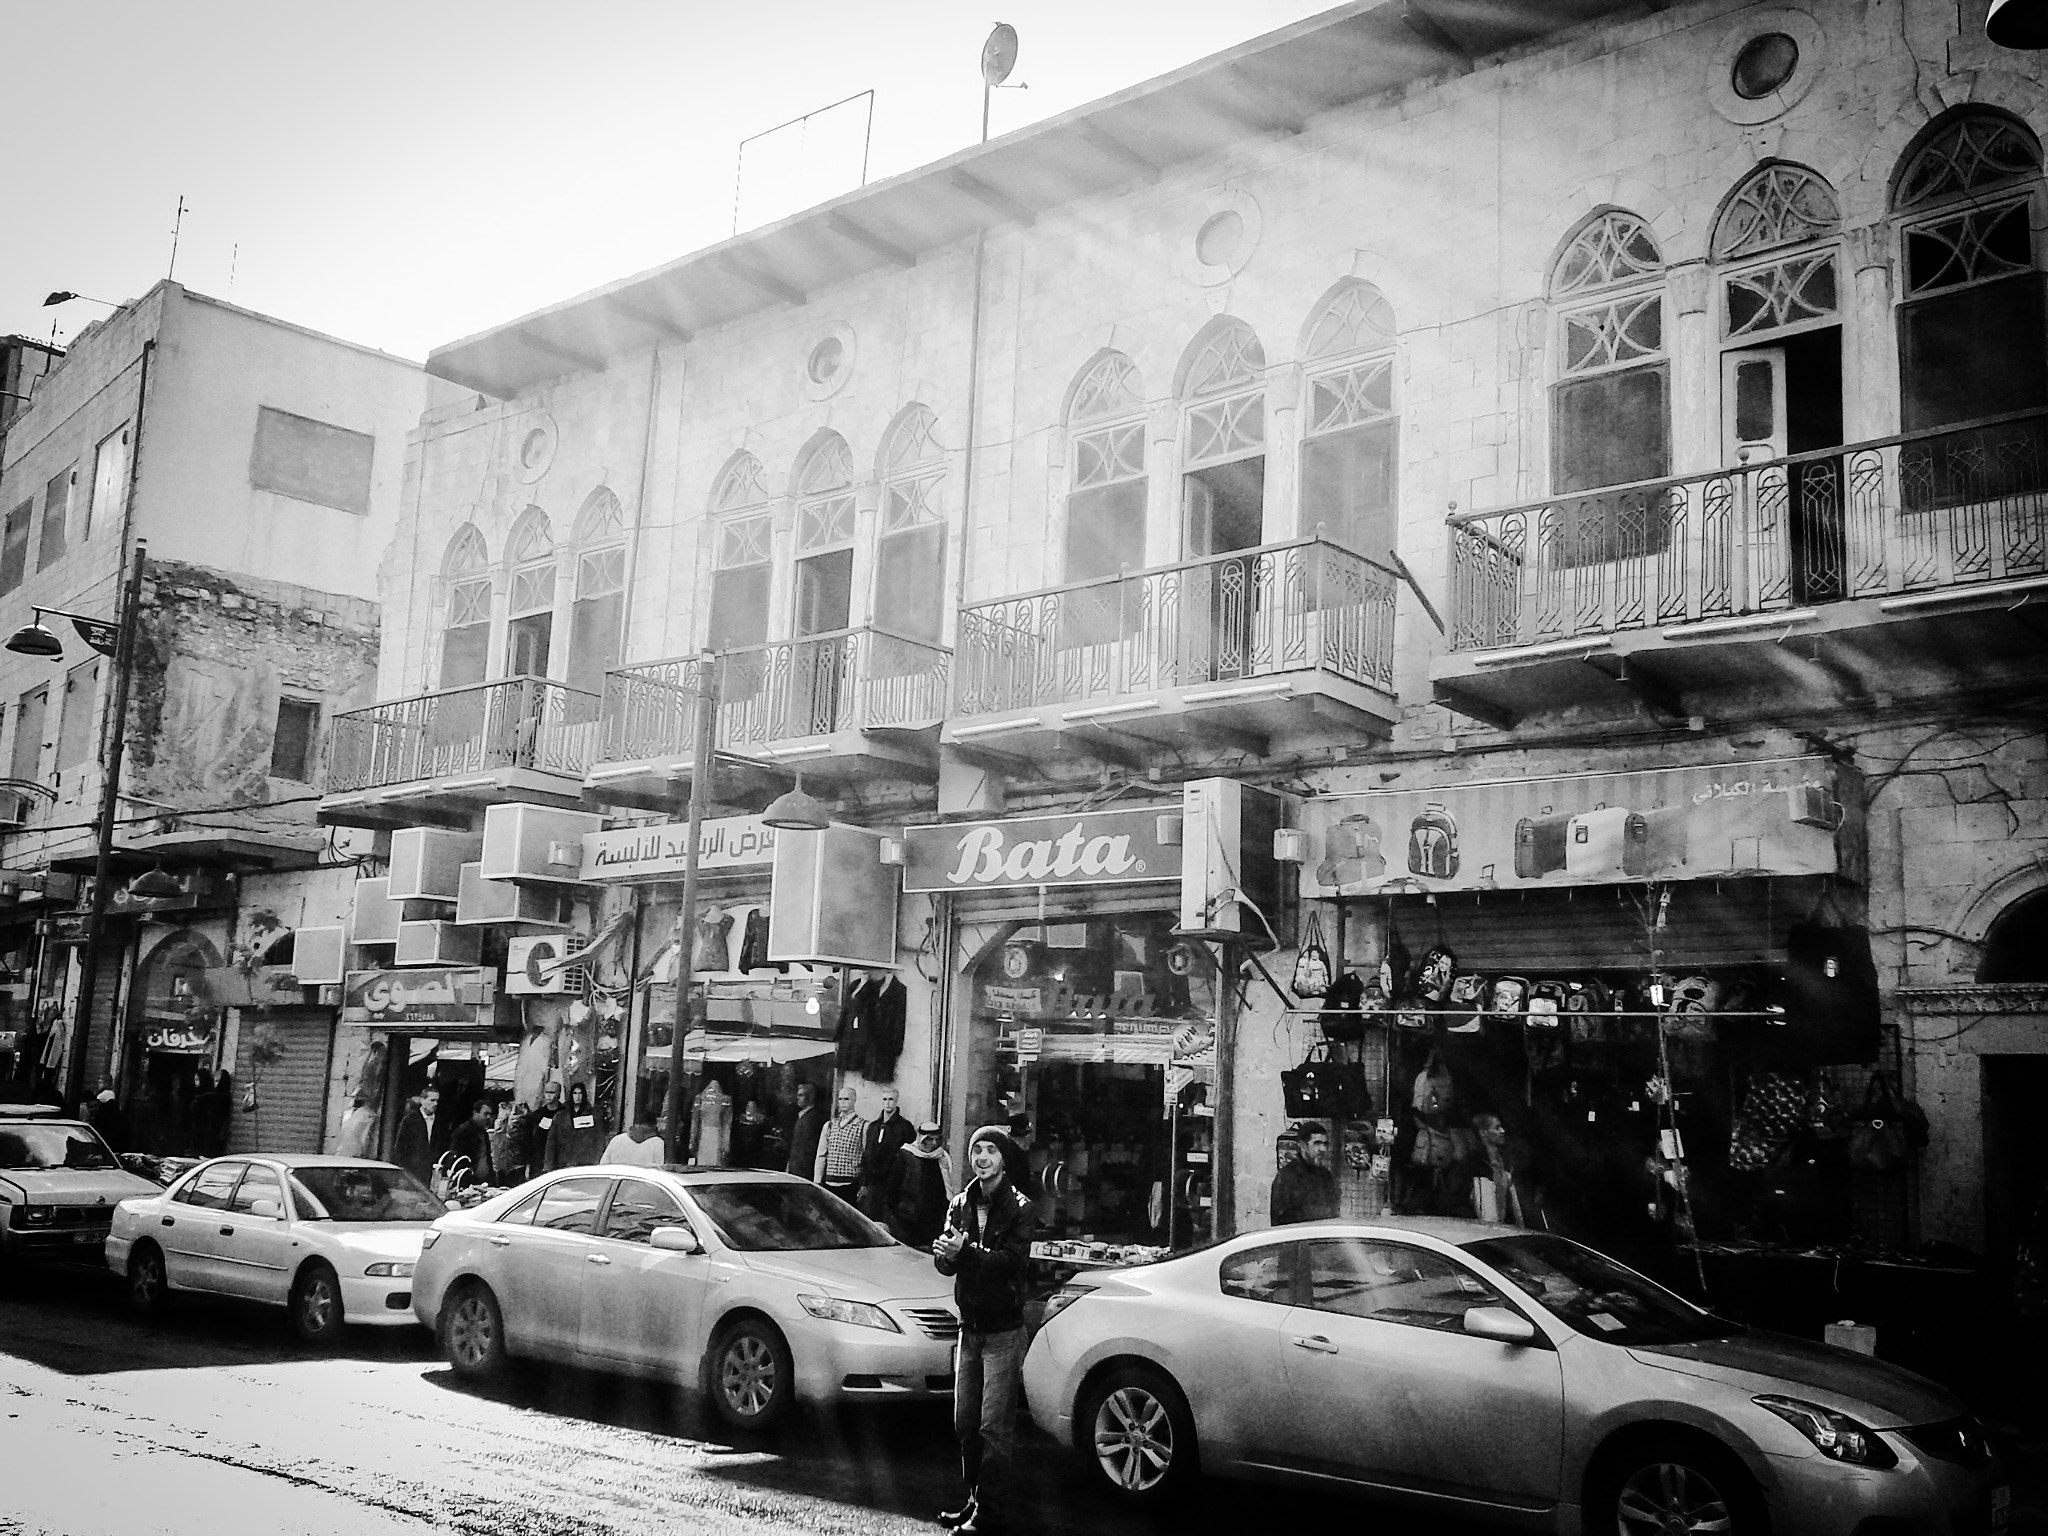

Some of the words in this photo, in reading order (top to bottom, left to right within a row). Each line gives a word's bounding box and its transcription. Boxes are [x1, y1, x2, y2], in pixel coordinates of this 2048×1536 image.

[664, 827, 725, 865] الريد
[729, 825, 775, 858] عرض
[946, 821, 1136, 884] Bata
